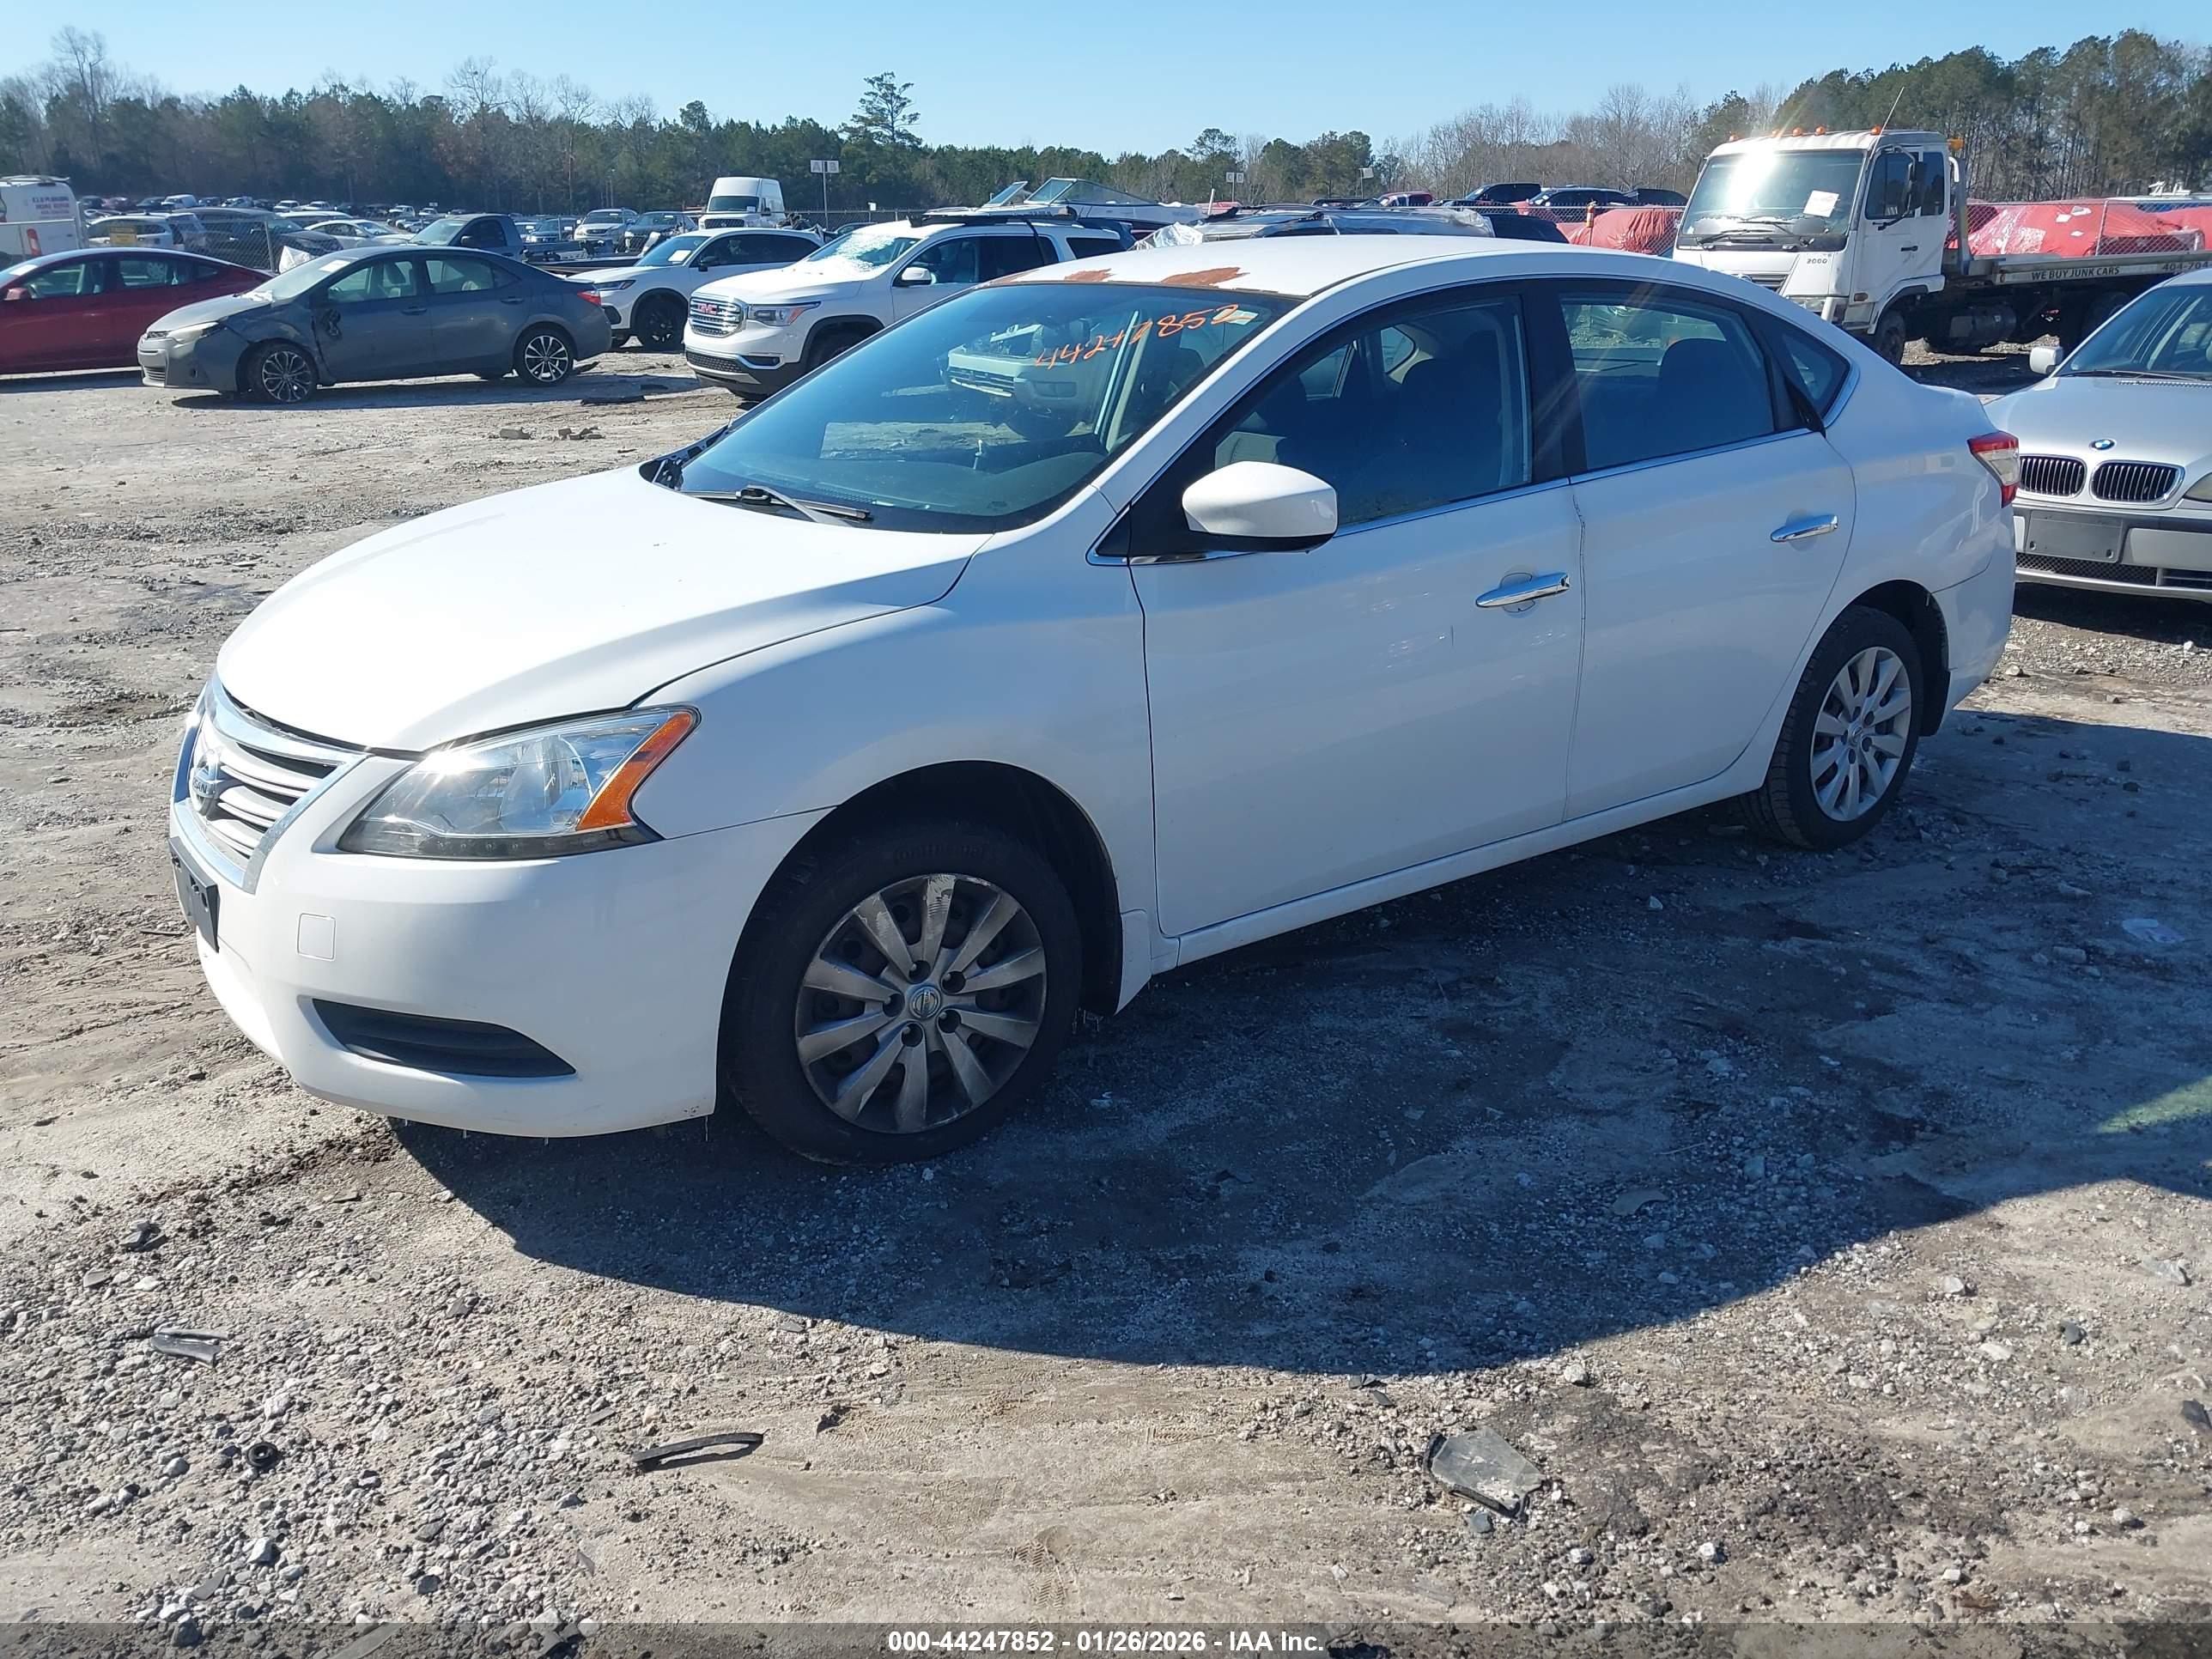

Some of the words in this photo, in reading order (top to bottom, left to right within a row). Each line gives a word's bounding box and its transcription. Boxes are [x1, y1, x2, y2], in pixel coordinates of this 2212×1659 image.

[2031, 270, 2047, 281] WE
[2048, 270, 2069, 279] BUY
[2069, 268, 2094, 277] JUNK
[2096, 266, 2120, 276] CARS
[697, 303, 719, 314] GMC
